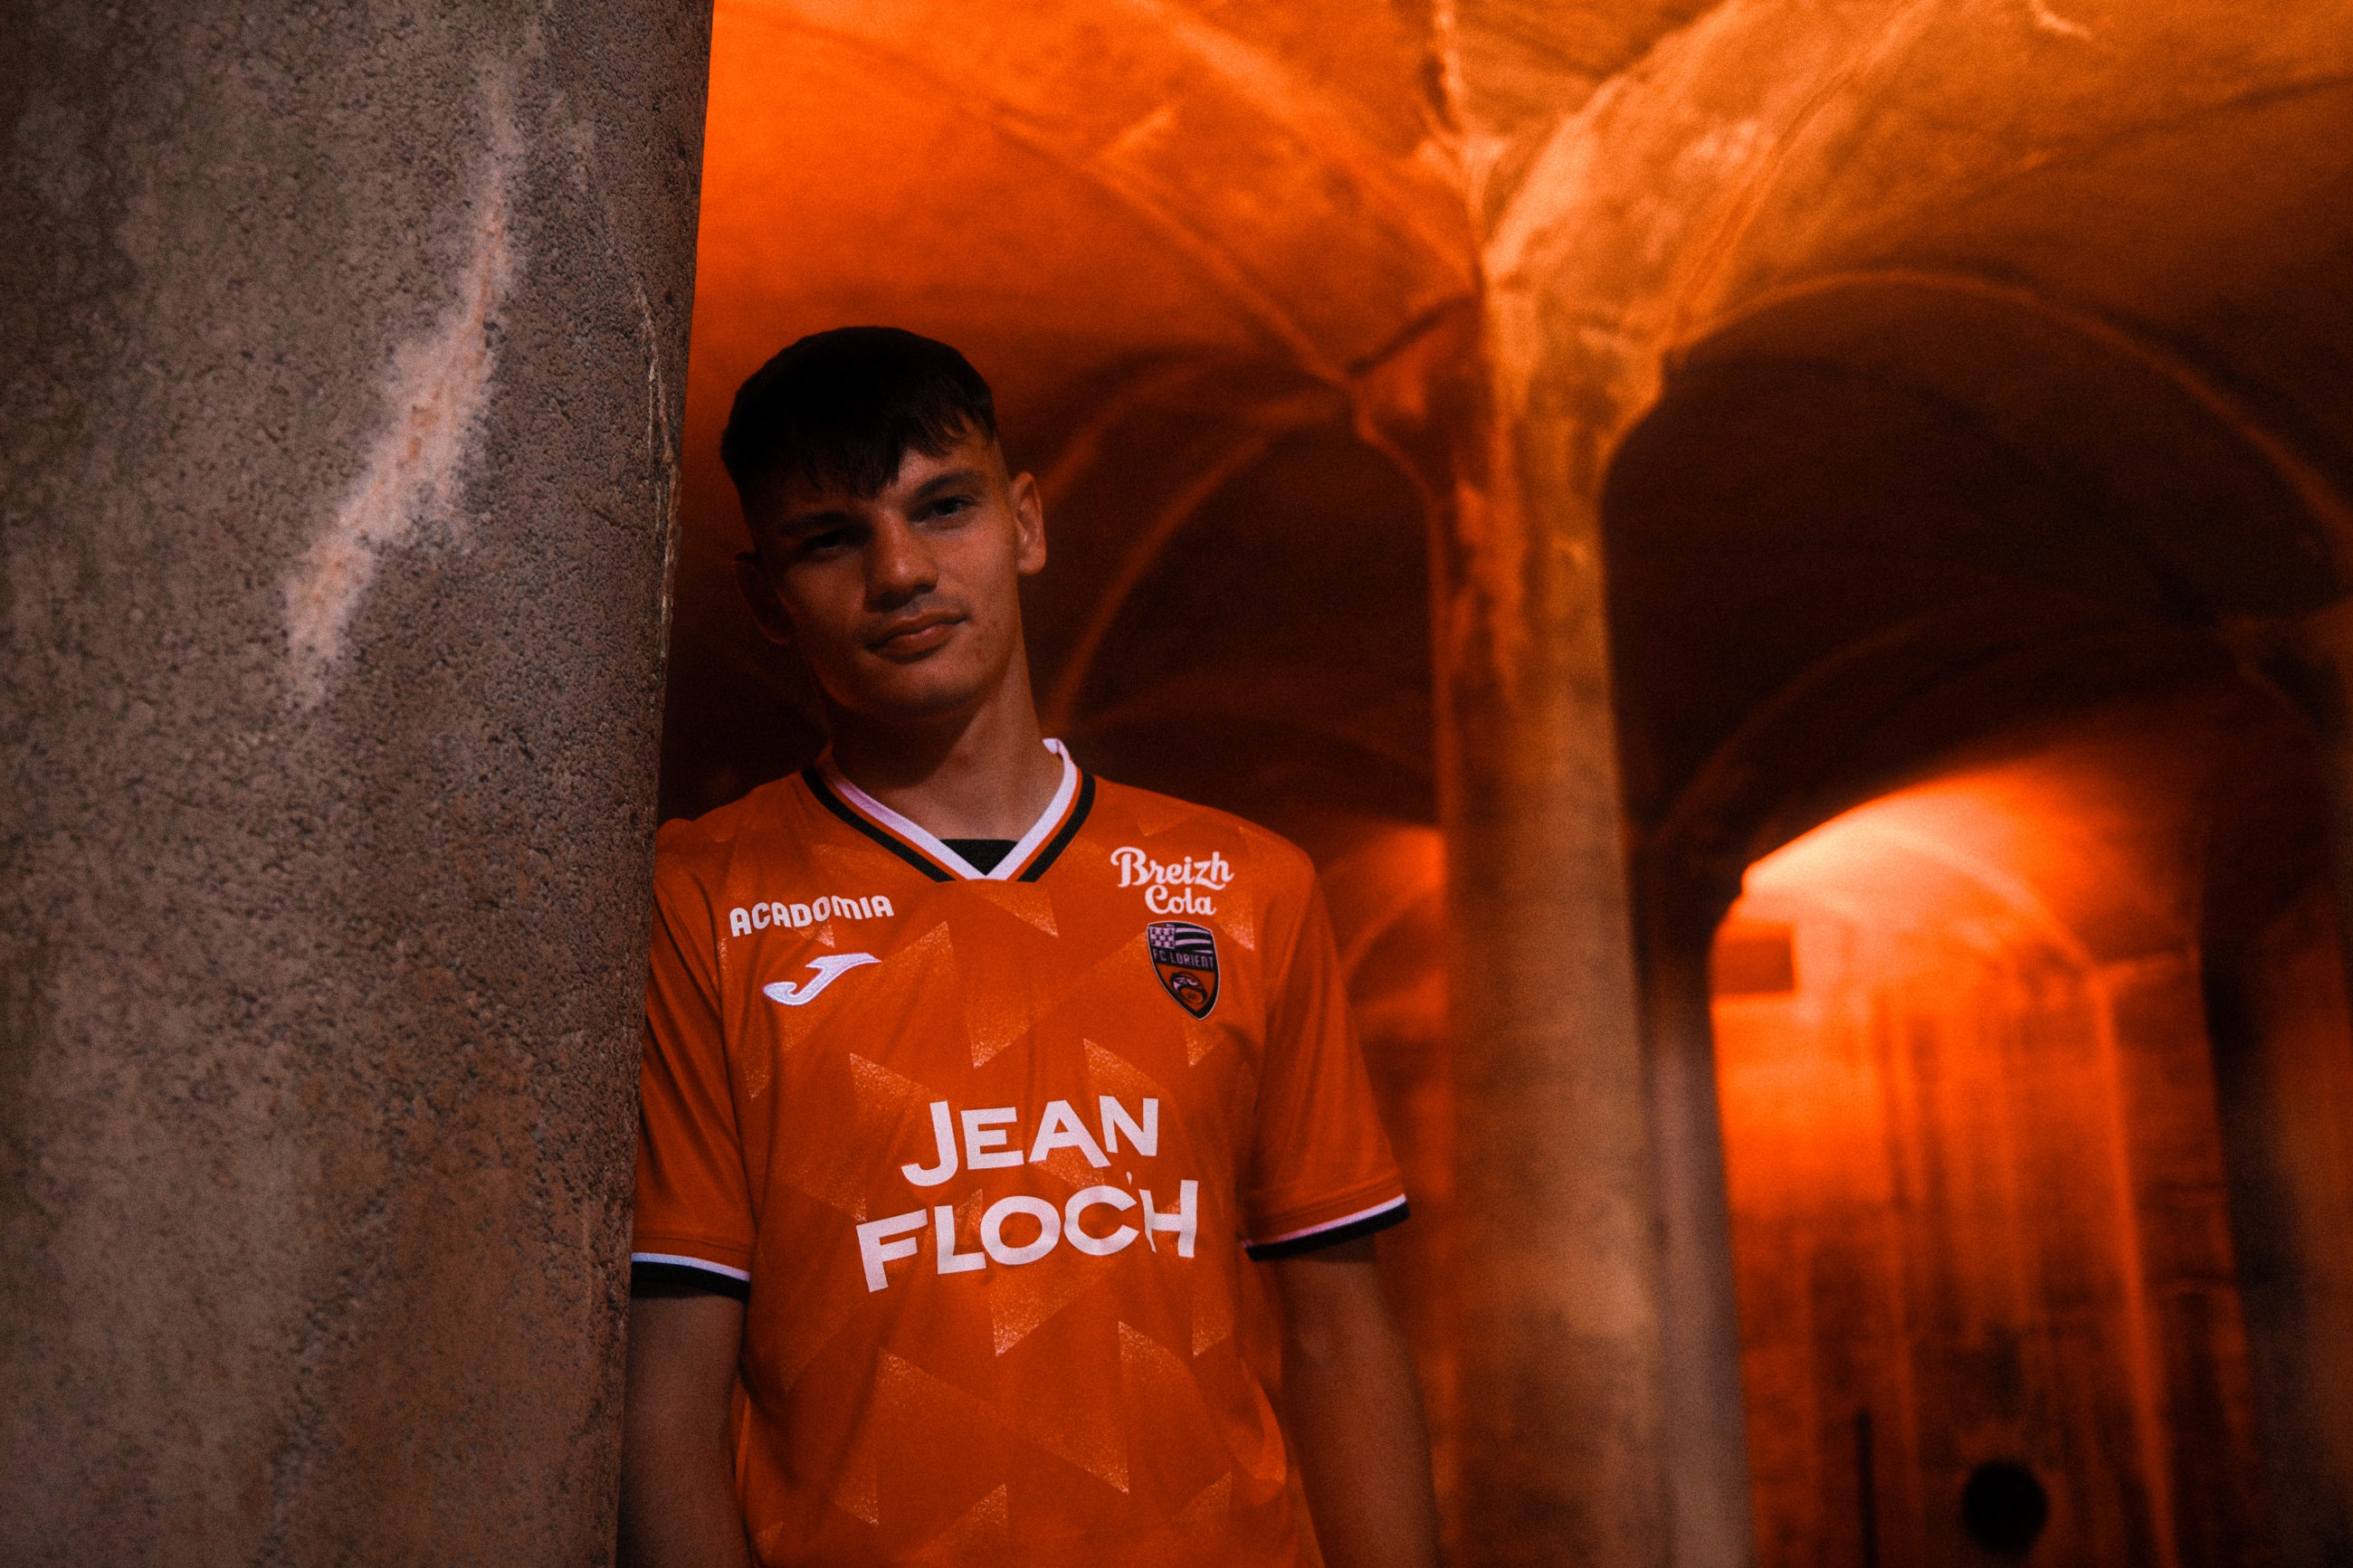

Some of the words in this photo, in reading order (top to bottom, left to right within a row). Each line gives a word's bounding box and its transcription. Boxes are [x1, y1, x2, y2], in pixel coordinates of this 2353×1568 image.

[1110, 846, 1234, 890] Breizh
[729, 895, 895, 937] ACADOMIA
[1145, 884, 1216, 916] Cola
[1152, 948, 1167, 962] FC
[1169, 951, 1214, 969] LORIENT
[900, 1095, 1159, 1187] JEAN
